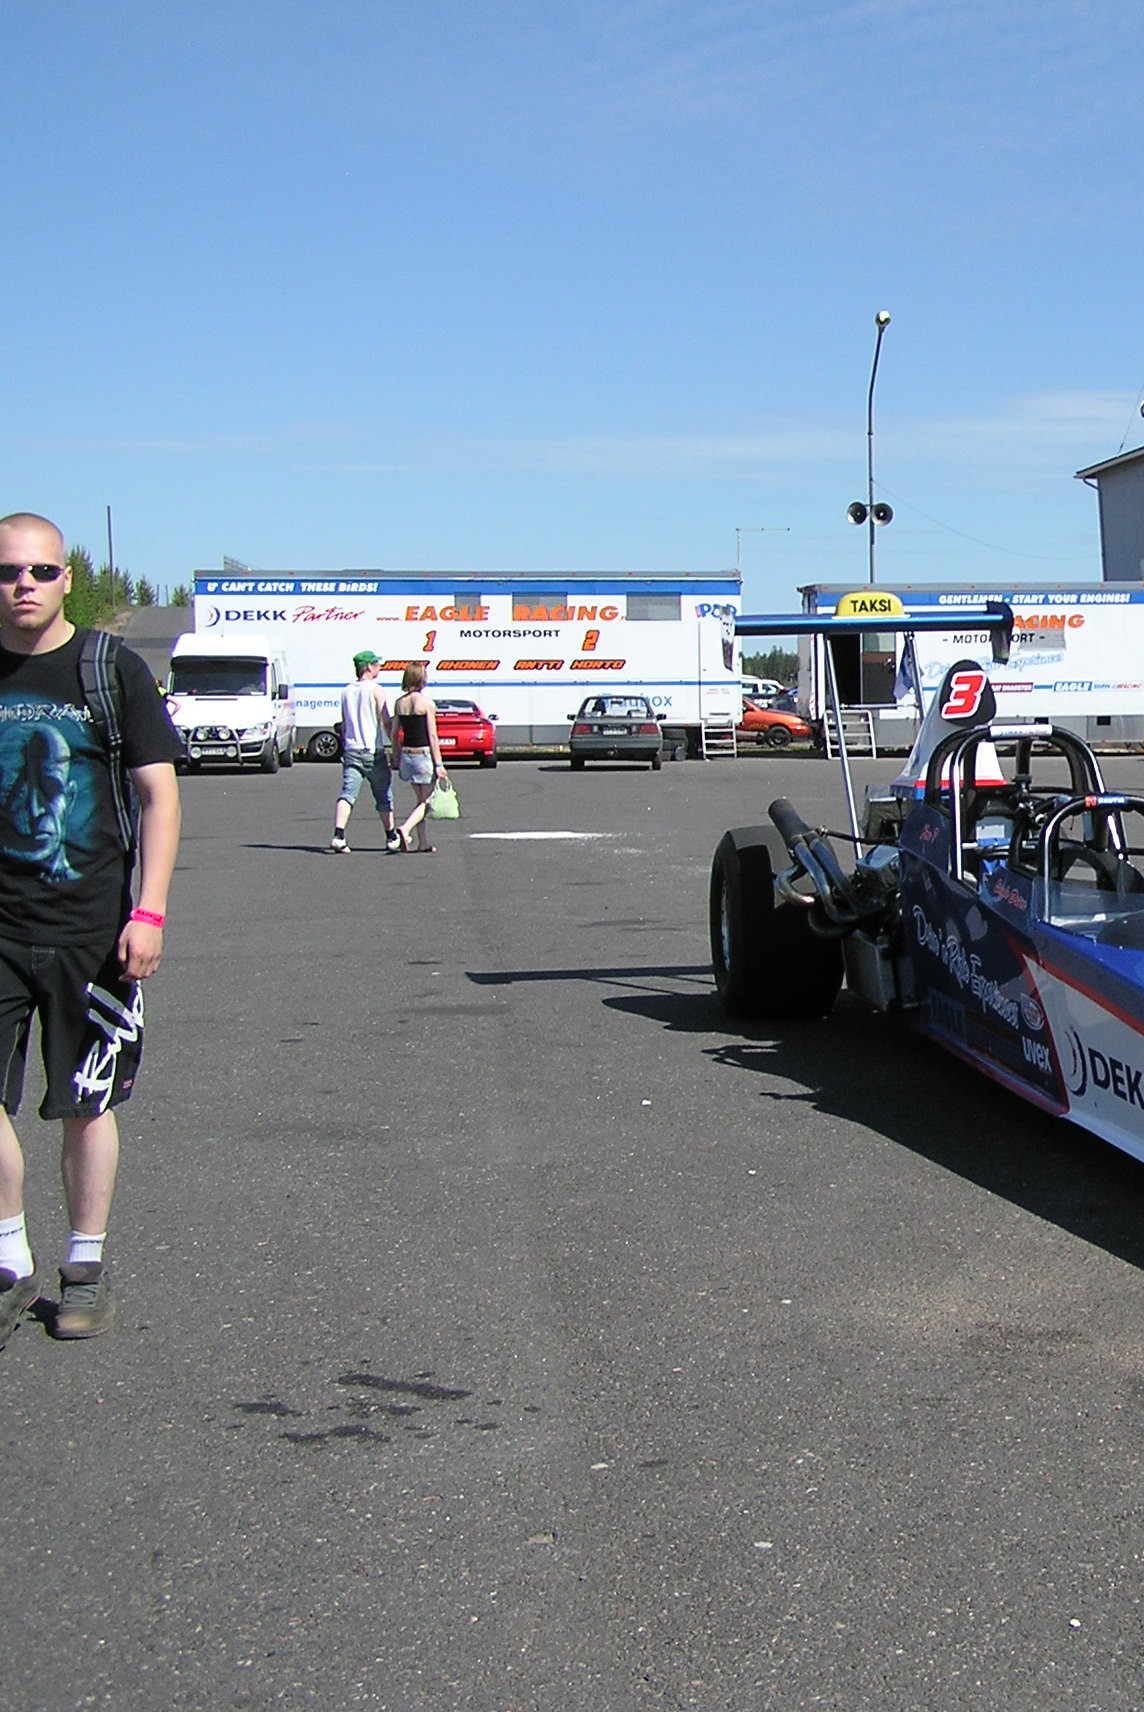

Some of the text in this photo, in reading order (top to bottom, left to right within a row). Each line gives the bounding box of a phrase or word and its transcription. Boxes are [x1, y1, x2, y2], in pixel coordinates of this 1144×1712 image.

[257, 582, 295, 592] CATCH
[301, 582, 336, 592] THESE
[850, 599, 892, 612] TAKSI
[939, 594, 1003, 604] GENTLEMEN
[1012, 594, 1043, 604] START
[1048, 594, 1077, 604] YOUR
[1080, 593, 1130, 603] ENGINES!
[225, 605, 366, 624] DEKK Partner
[405, 606, 490, 621] EAGLE
[512, 605, 619, 621] RACING
[1013, 614, 1085, 629] ACING
[423, 630, 437, 651] 1
[459, 629, 560, 638] MOTORSPORT
[582, 630, 600, 651] 2
[380, 660, 430, 671] JAN
[942, 671, 986, 717] 3
[1054, 682, 1092, 692] EAGLE
[296, 700, 340, 710] nageme
[1022, 1036, 1052, 1072] uvex
